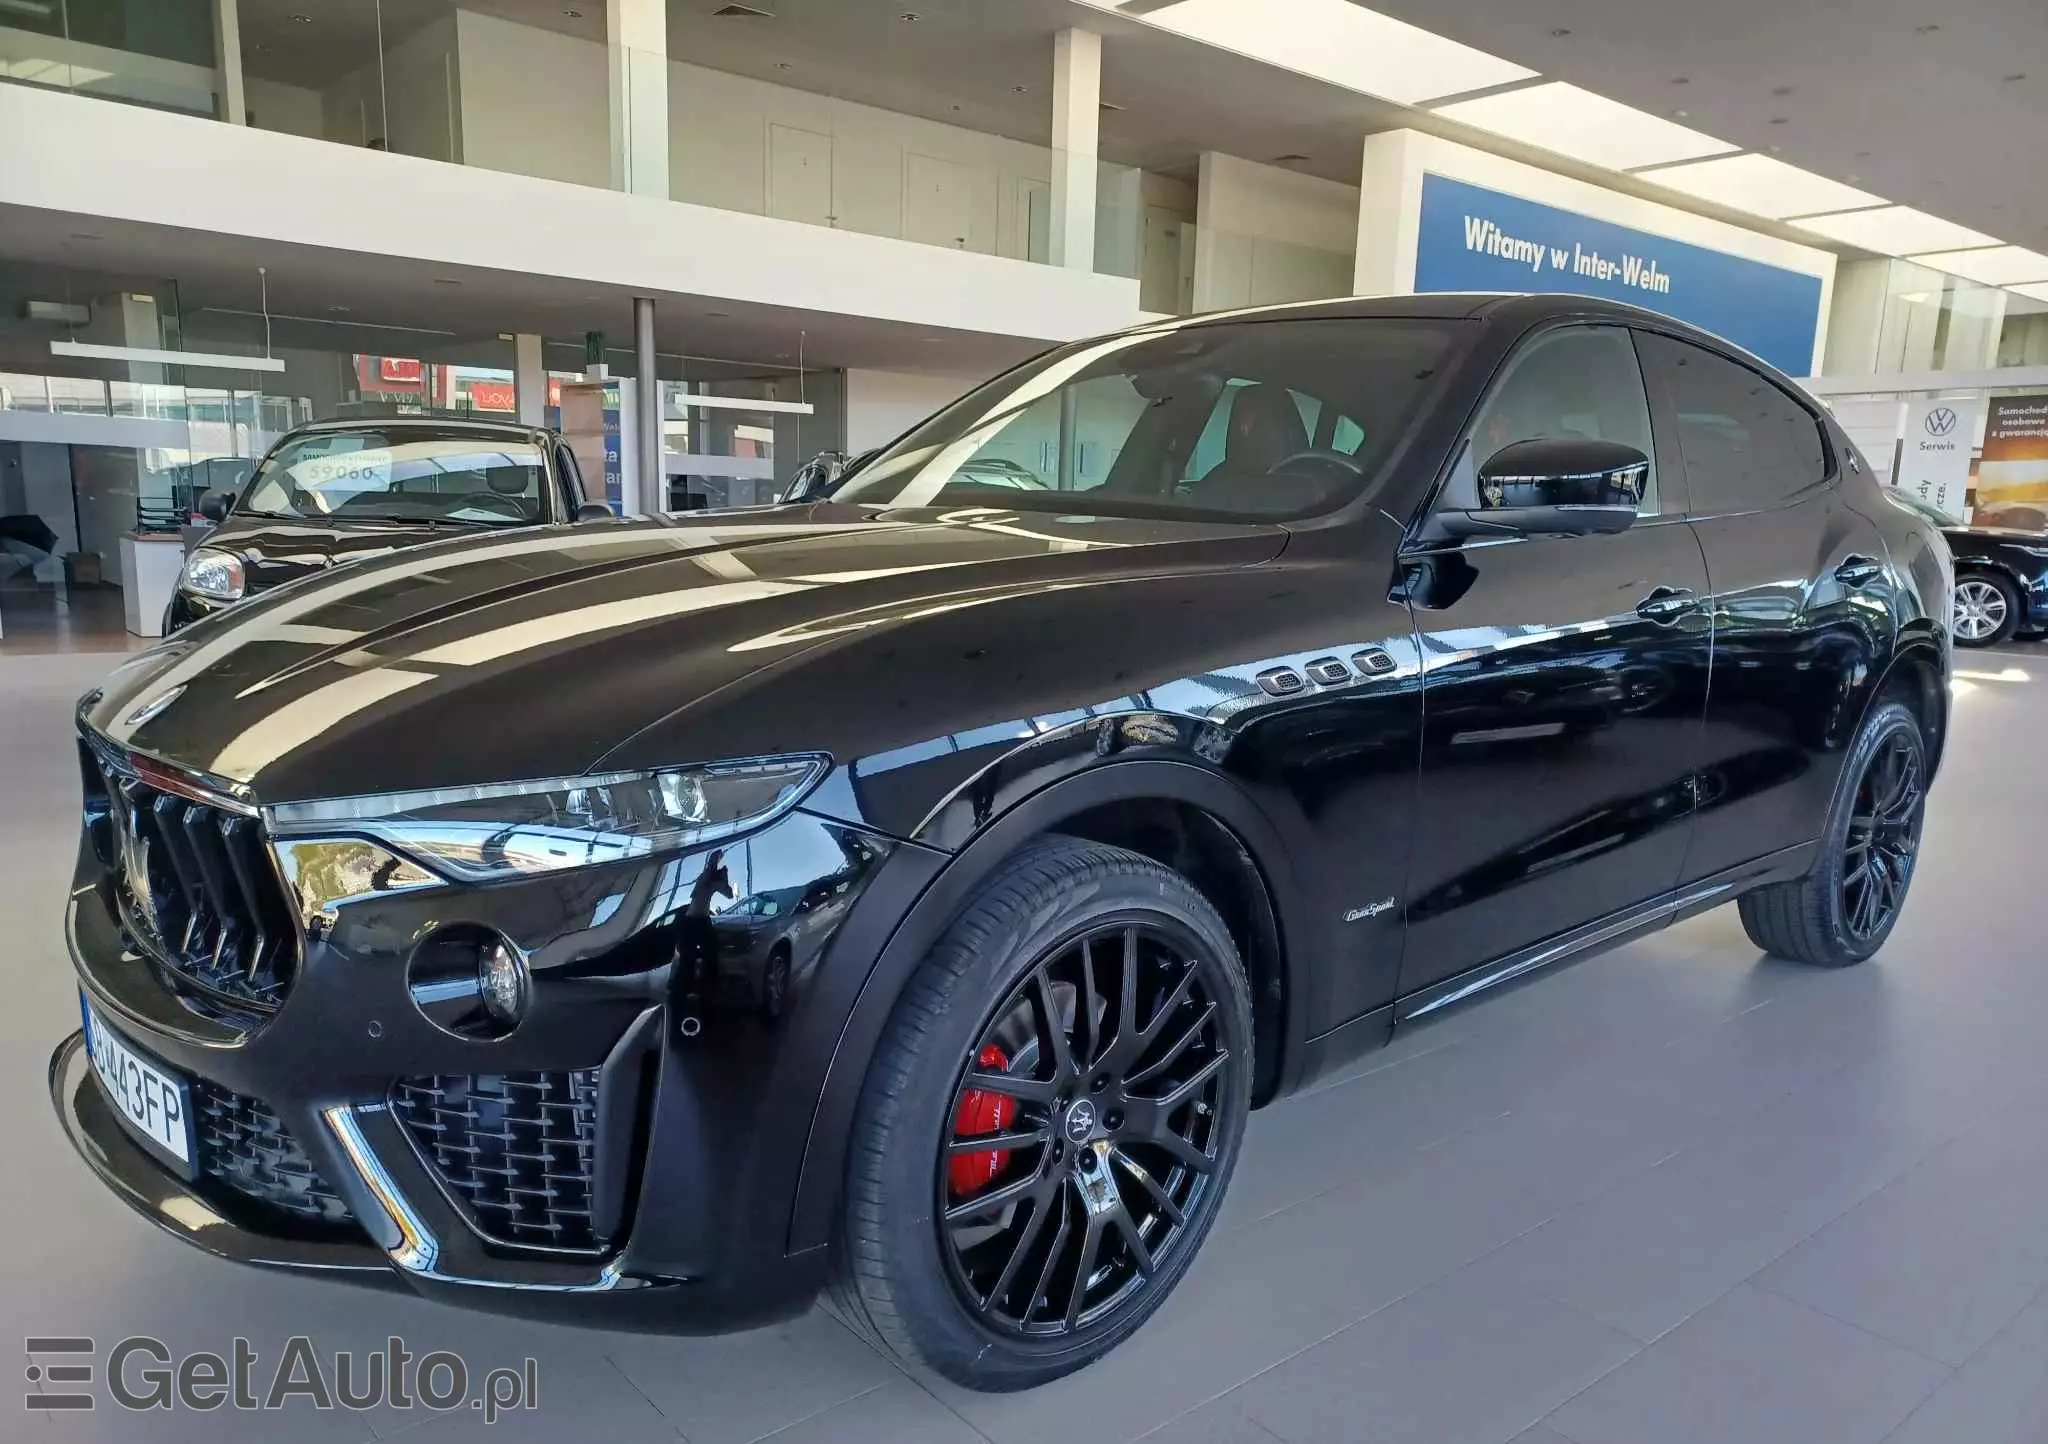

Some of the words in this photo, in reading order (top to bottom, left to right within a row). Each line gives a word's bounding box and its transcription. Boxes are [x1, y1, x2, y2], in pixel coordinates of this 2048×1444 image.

[1464, 215, 1546, 273] Witamy
[1551, 247, 1569, 271] w
[1573, 242, 1670, 293] Inter-Welm
[2002, 417, 2046, 426] osobowe
[1920, 440, 1955, 452] Serwis
